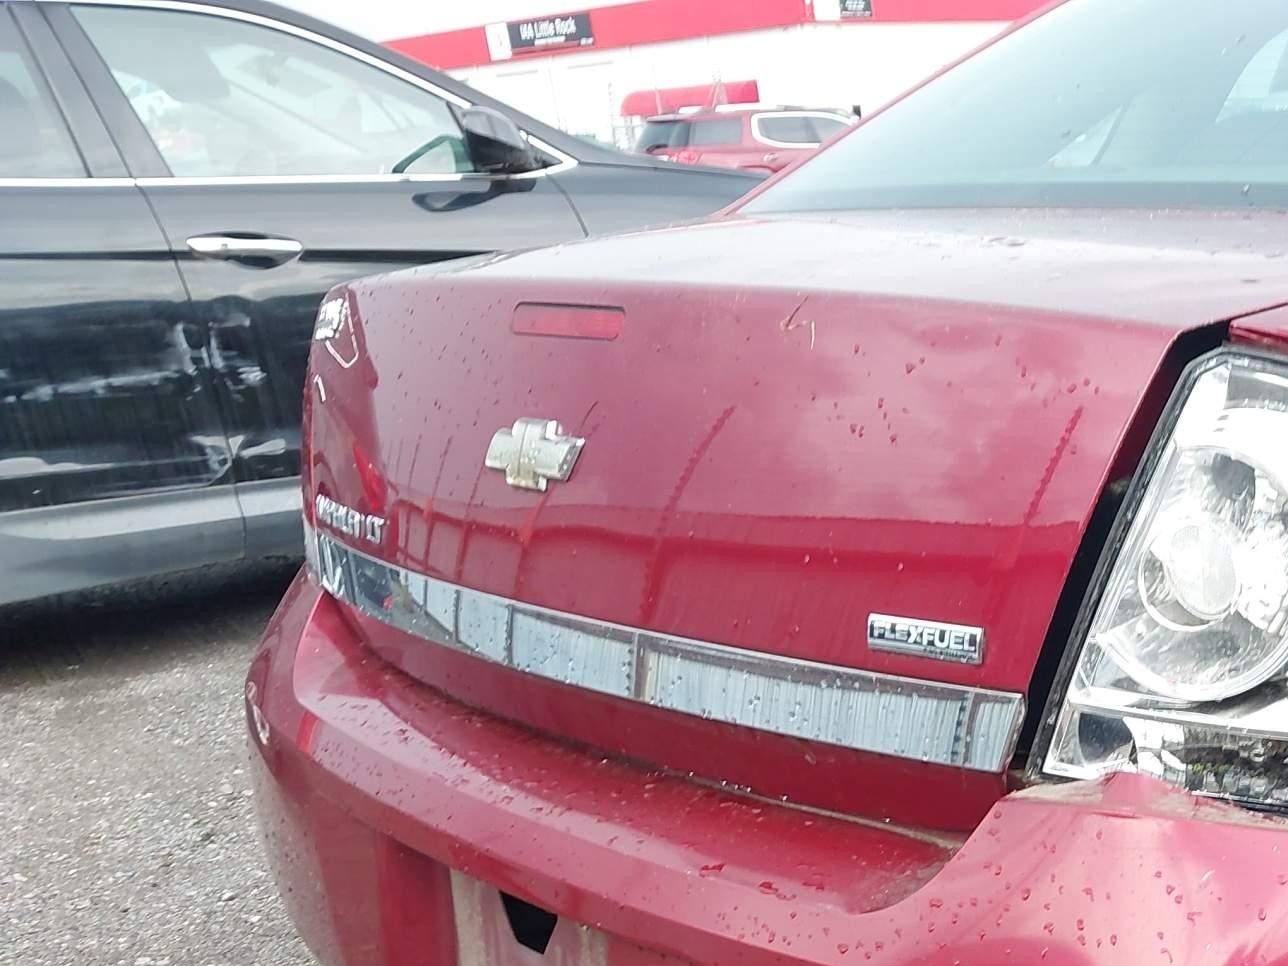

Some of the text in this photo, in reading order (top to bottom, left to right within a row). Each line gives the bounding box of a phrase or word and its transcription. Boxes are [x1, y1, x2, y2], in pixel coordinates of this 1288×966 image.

[533, 20, 556, 39] Little
[554, 16, 577, 35] Rock
[872, 620, 976, 652] FLEXFUEL
